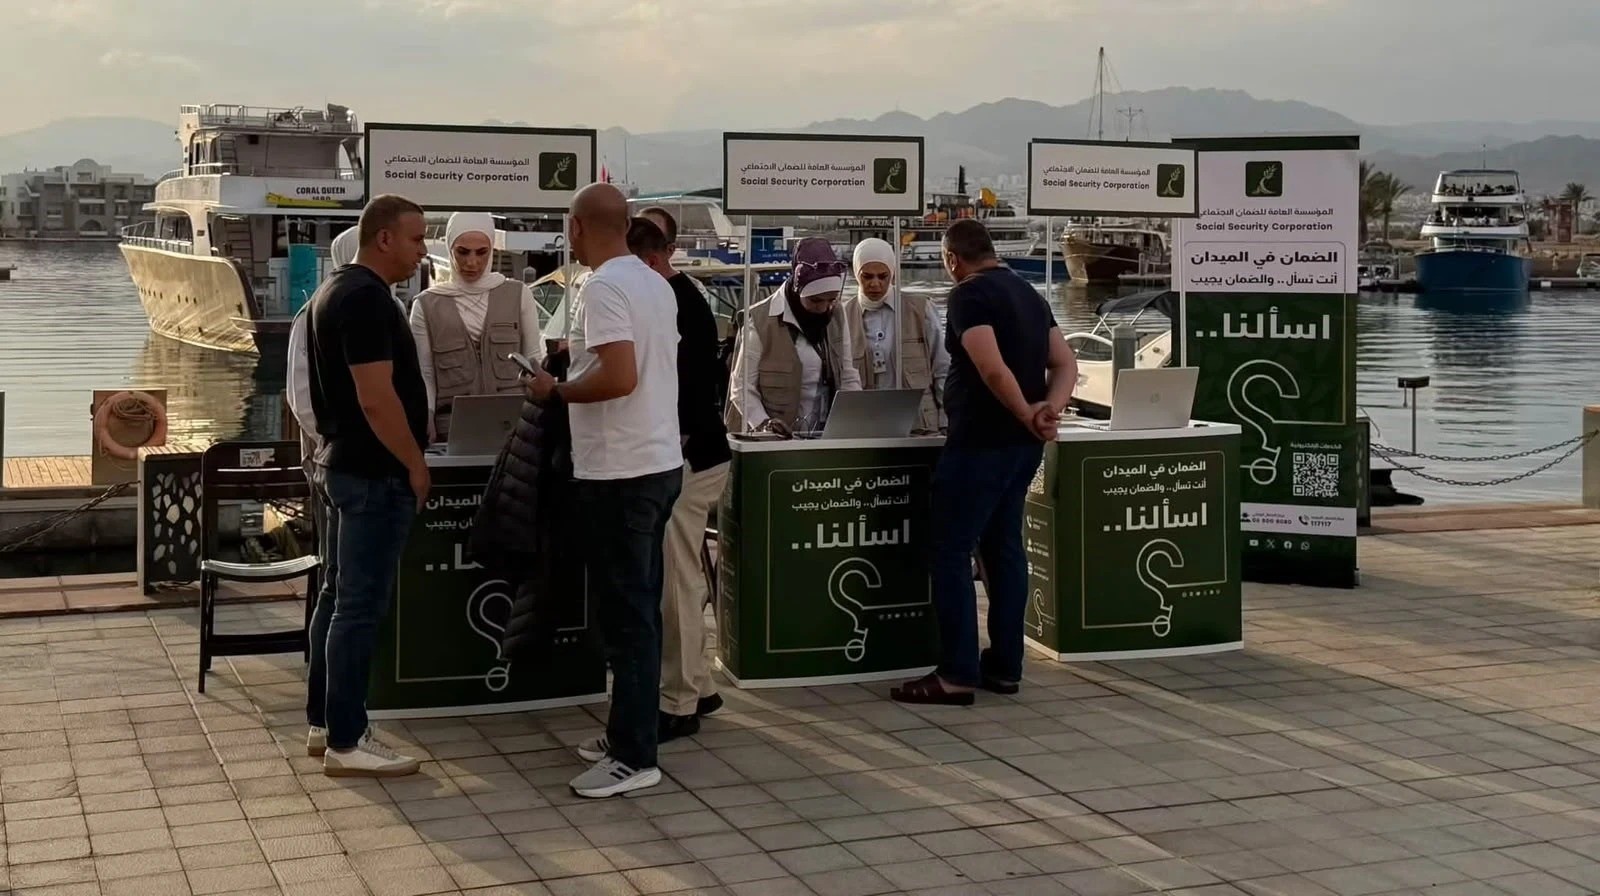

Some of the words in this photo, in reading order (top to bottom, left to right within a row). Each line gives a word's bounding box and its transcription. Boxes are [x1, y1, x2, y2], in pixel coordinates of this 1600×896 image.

[428, 156, 461, 166] للضمان
[463, 156, 488, 165] العامة
[490, 157, 530, 167] المؤسسة
[778, 163, 806, 172] للضمان
[831, 164, 866, 173] المؤسسة
[385, 170, 417, 179] Social
[420, 171, 464, 182] Security
[467, 172, 529, 183] Corporation
[741, 177, 768, 186] Social
[771, 177, 808, 187] Security
[811, 178, 865, 187] Corporation
[1043, 178, 1067, 186] Social
[1069, 180, 1101, 189] Security
[1103, 181, 1150, 190] Corporation
[1236, 208, 1266, 217] للضمان
[1294, 208, 1334, 217] المؤسسة
[1196, 222, 1225, 230] Social
[1228, 222, 1269, 232] Security
[1272, 222, 1333, 232] Corporation
[1191, 251, 1248, 265] الميدان
[1253, 251, 1275, 269] في
[1280, 251, 1338, 265] الضمان
[1191, 276, 1222, 286] يجيب
[1225, 274, 1274, 286] والضمان
[1316, 274, 1338, 285] أنت
[1103, 464, 1146, 478] الميدان
[1150, 464, 1165, 479] في
[1168, 461, 1206, 475] الضمان
[792, 478, 840, 492] الميدان
[844, 477, 862, 494] في
[866, 474, 910, 489] الضمان
[1192, 478, 1206, 489] أنت
[1103, 486, 1128, 496] يجيب
[1129, 482, 1165, 494] والضمان
[426, 494, 481, 510] الميدان
[821, 498, 861, 510] والضمان
[893, 492, 909, 504] أنت
[792, 501, 819, 511] يجيب
[426, 521, 456, 531] يجيب
